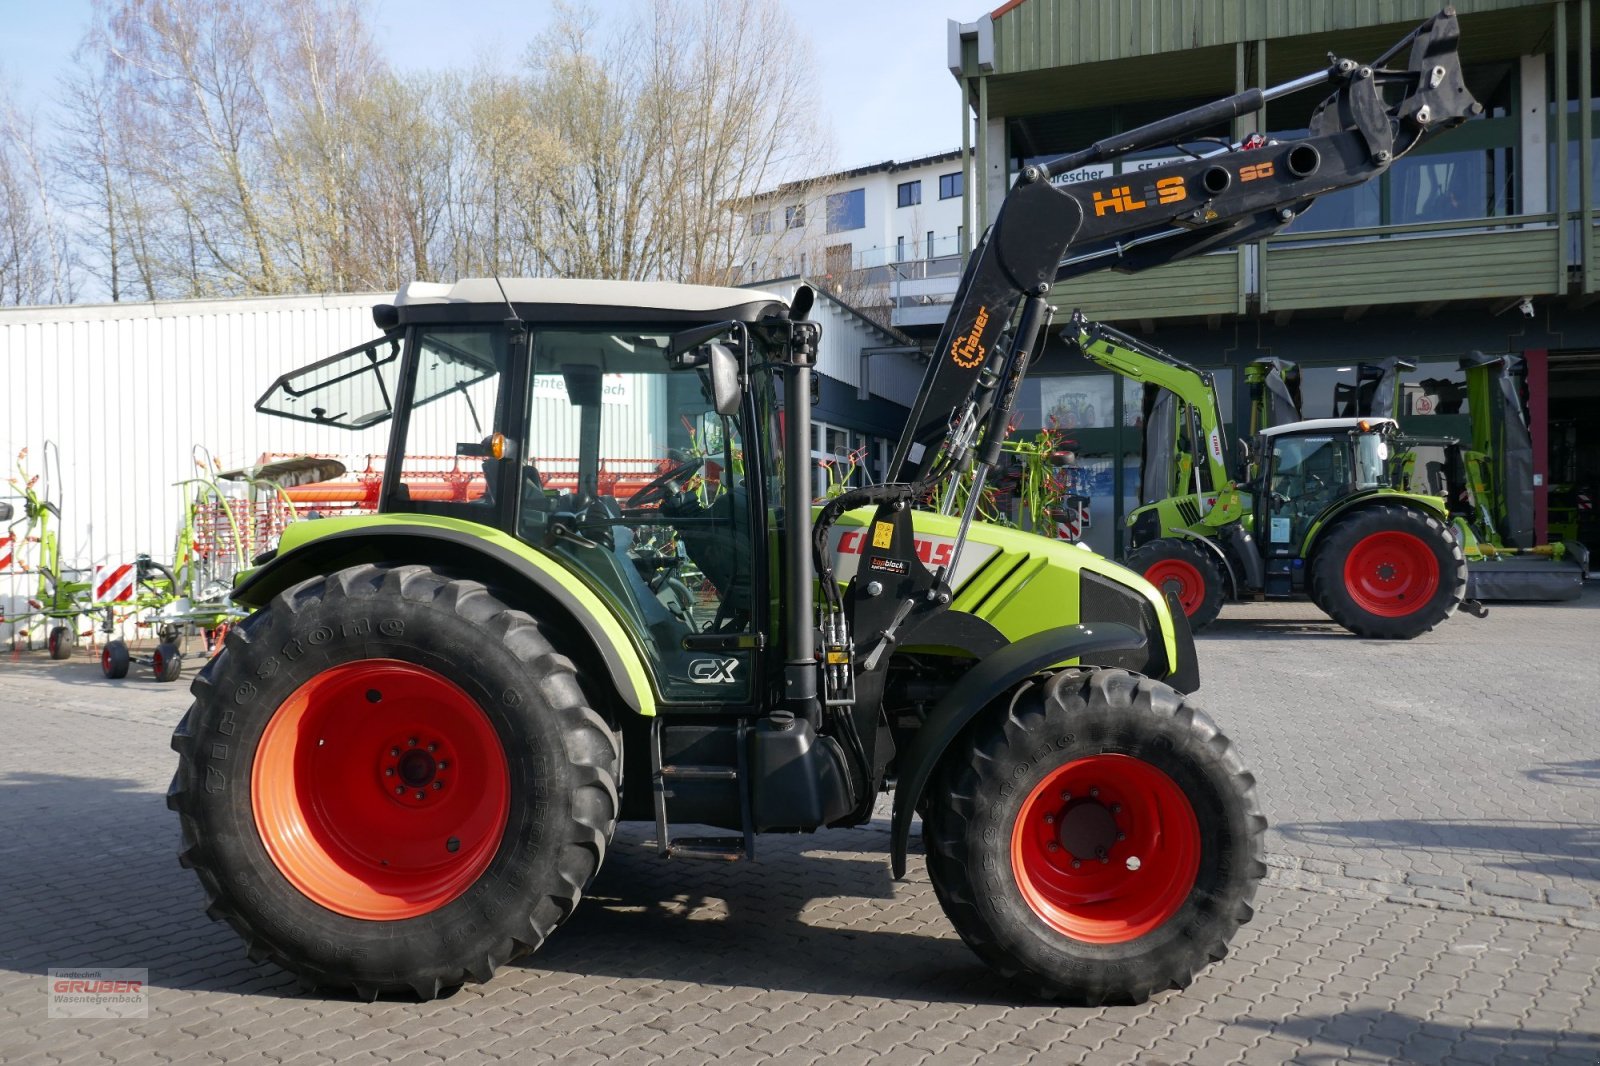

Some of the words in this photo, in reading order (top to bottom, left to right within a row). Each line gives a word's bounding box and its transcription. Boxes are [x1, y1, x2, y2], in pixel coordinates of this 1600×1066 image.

[959, 305, 989, 359] hauer
[836, 531, 954, 567] CAS
[687, 657, 740, 684] CX
[205, 617, 406, 794] Firestone
